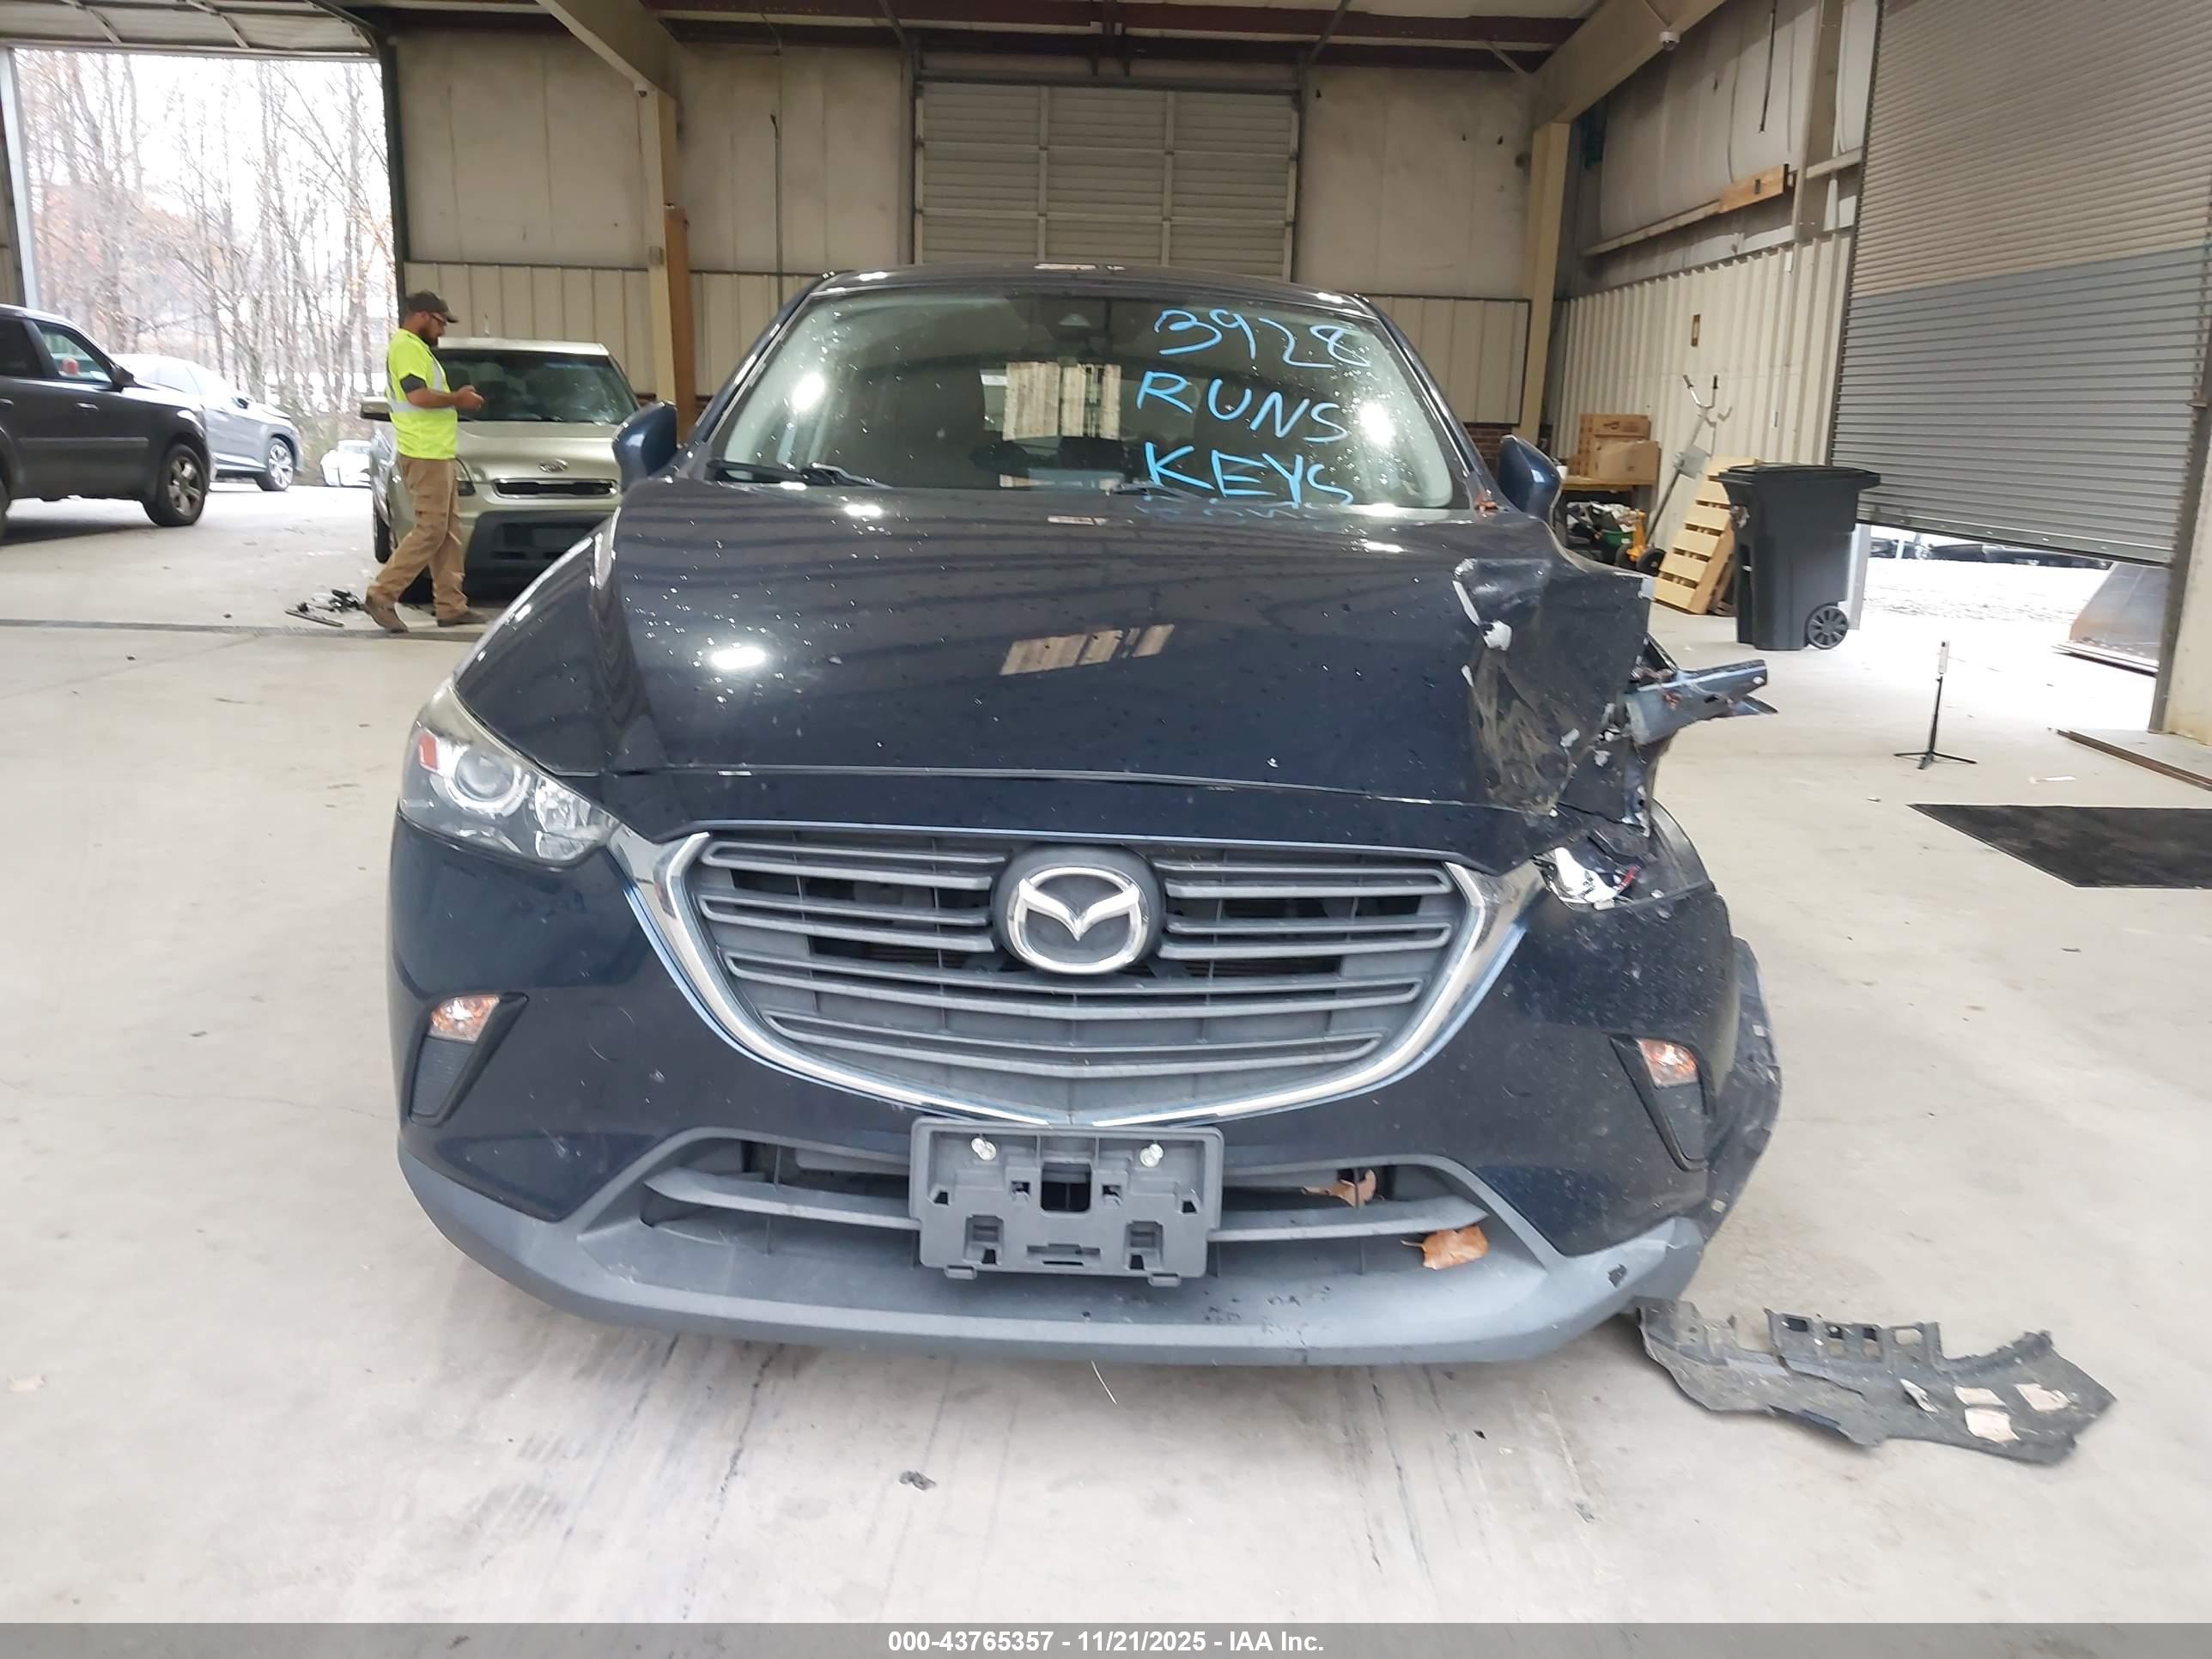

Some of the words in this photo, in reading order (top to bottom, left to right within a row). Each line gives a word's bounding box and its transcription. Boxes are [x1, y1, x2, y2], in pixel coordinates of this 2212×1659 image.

[1154, 308, 1372, 369] 3928
[1136, 371, 1349, 443] RUNS
[1145, 441, 1354, 509] KEYS
